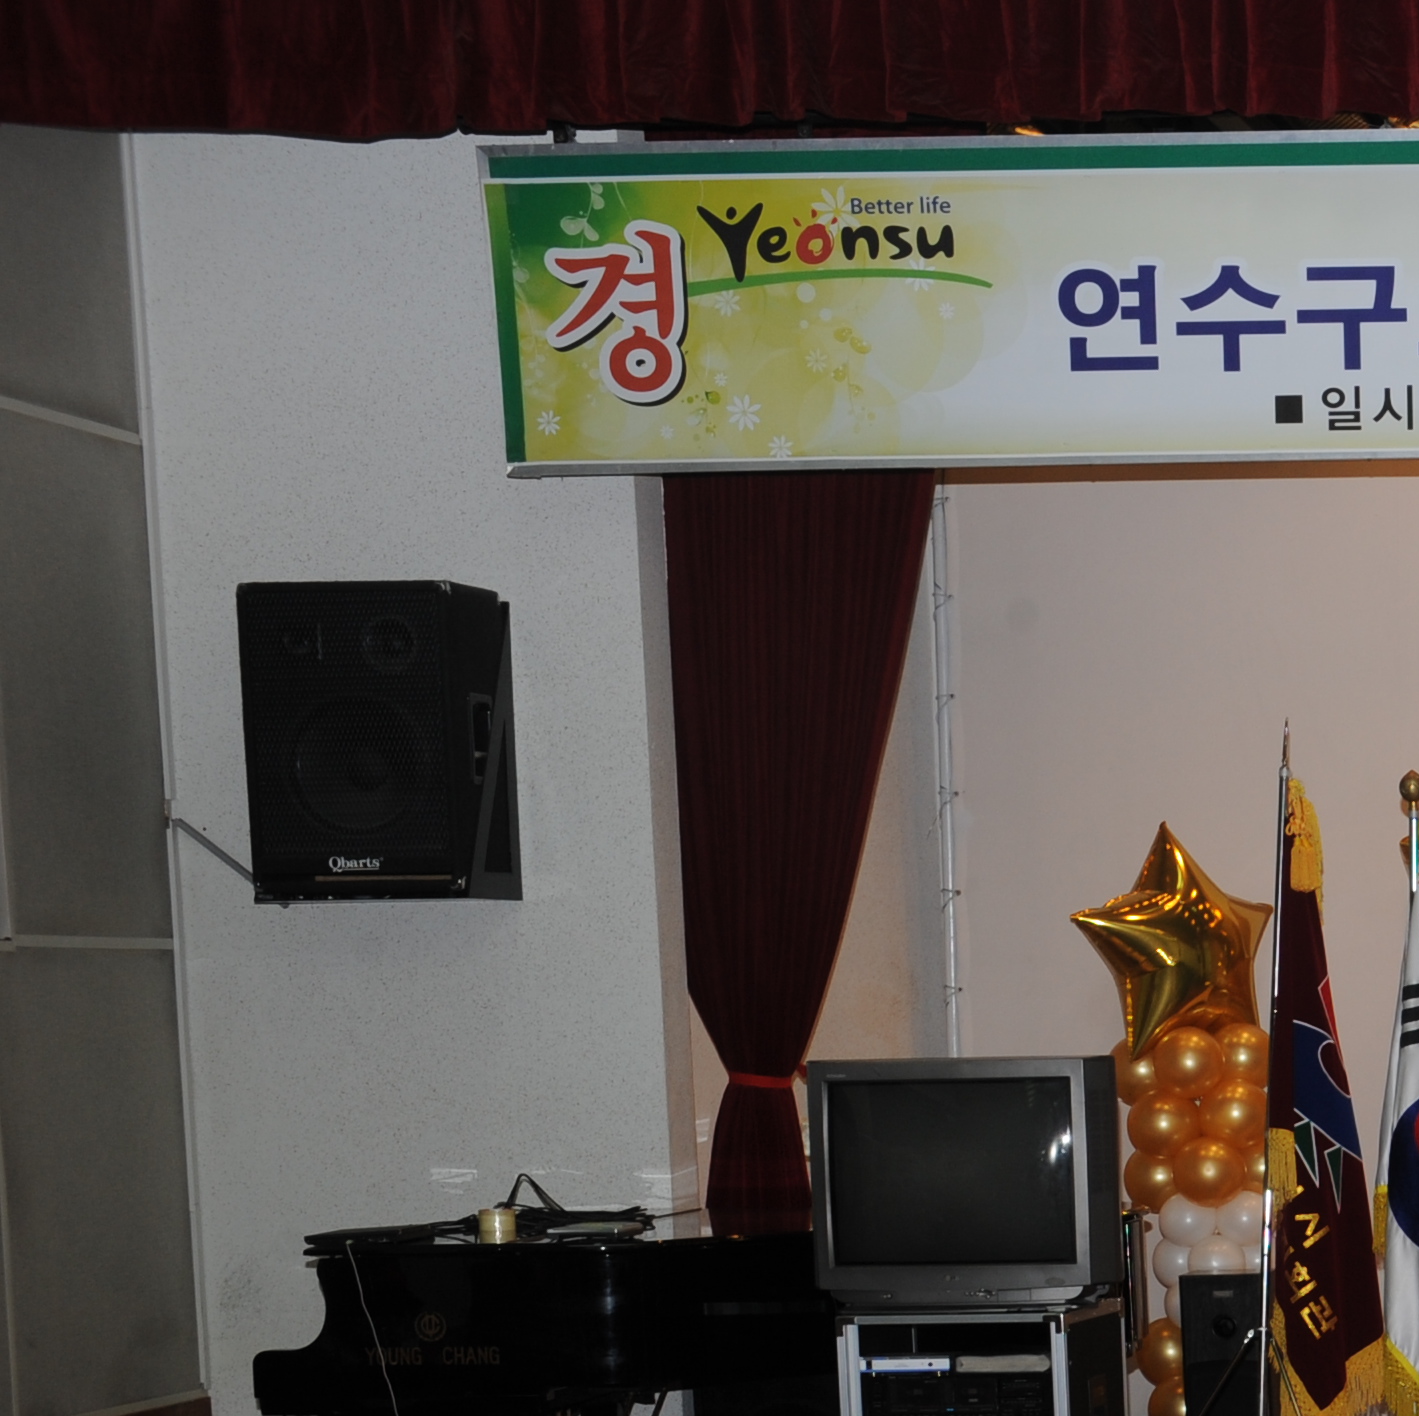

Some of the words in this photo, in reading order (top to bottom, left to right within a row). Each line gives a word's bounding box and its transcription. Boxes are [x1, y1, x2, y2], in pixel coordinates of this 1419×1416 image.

[849, 195, 912, 215] Better
[919, 195, 951, 215] life
[697, 201, 954, 282] Yeonsu
[552, 230, 675, 393] 경
[328, 856, 380, 873] Qbarts
[364, 1346, 423, 1367] YOUNG
[441, 1345, 501, 1366] CHANG
